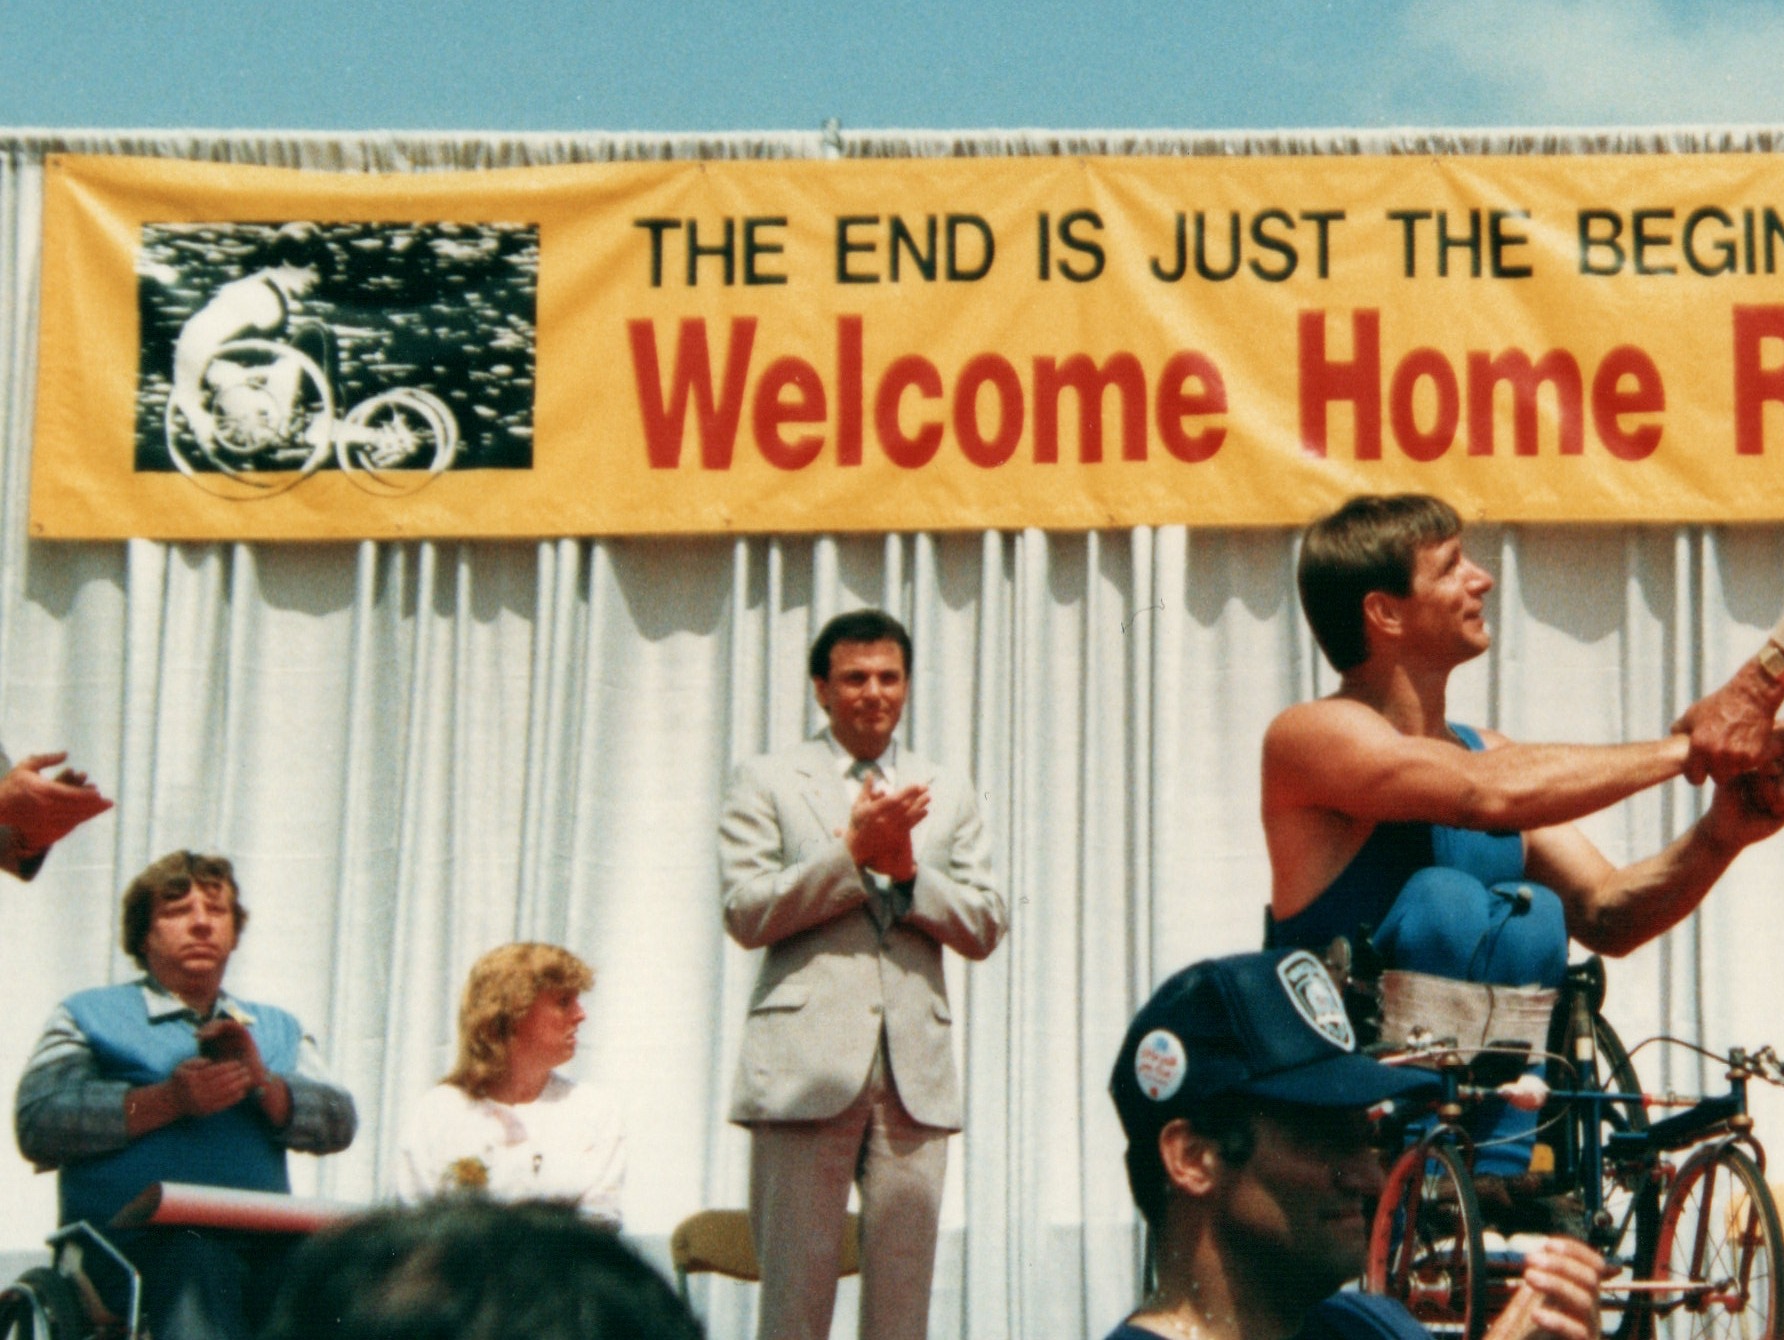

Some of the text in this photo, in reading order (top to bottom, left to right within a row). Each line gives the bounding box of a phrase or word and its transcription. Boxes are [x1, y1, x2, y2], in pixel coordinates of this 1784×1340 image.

[633, 216, 789, 288] THE
[835, 213, 997, 284] END
[1037, 209, 1107, 283] IS
[1150, 208, 1346, 283] JUST
[1387, 208, 1534, 280] THE
[626, 314, 1230, 471] Welcome
[1297, 308, 1667, 463] Home
